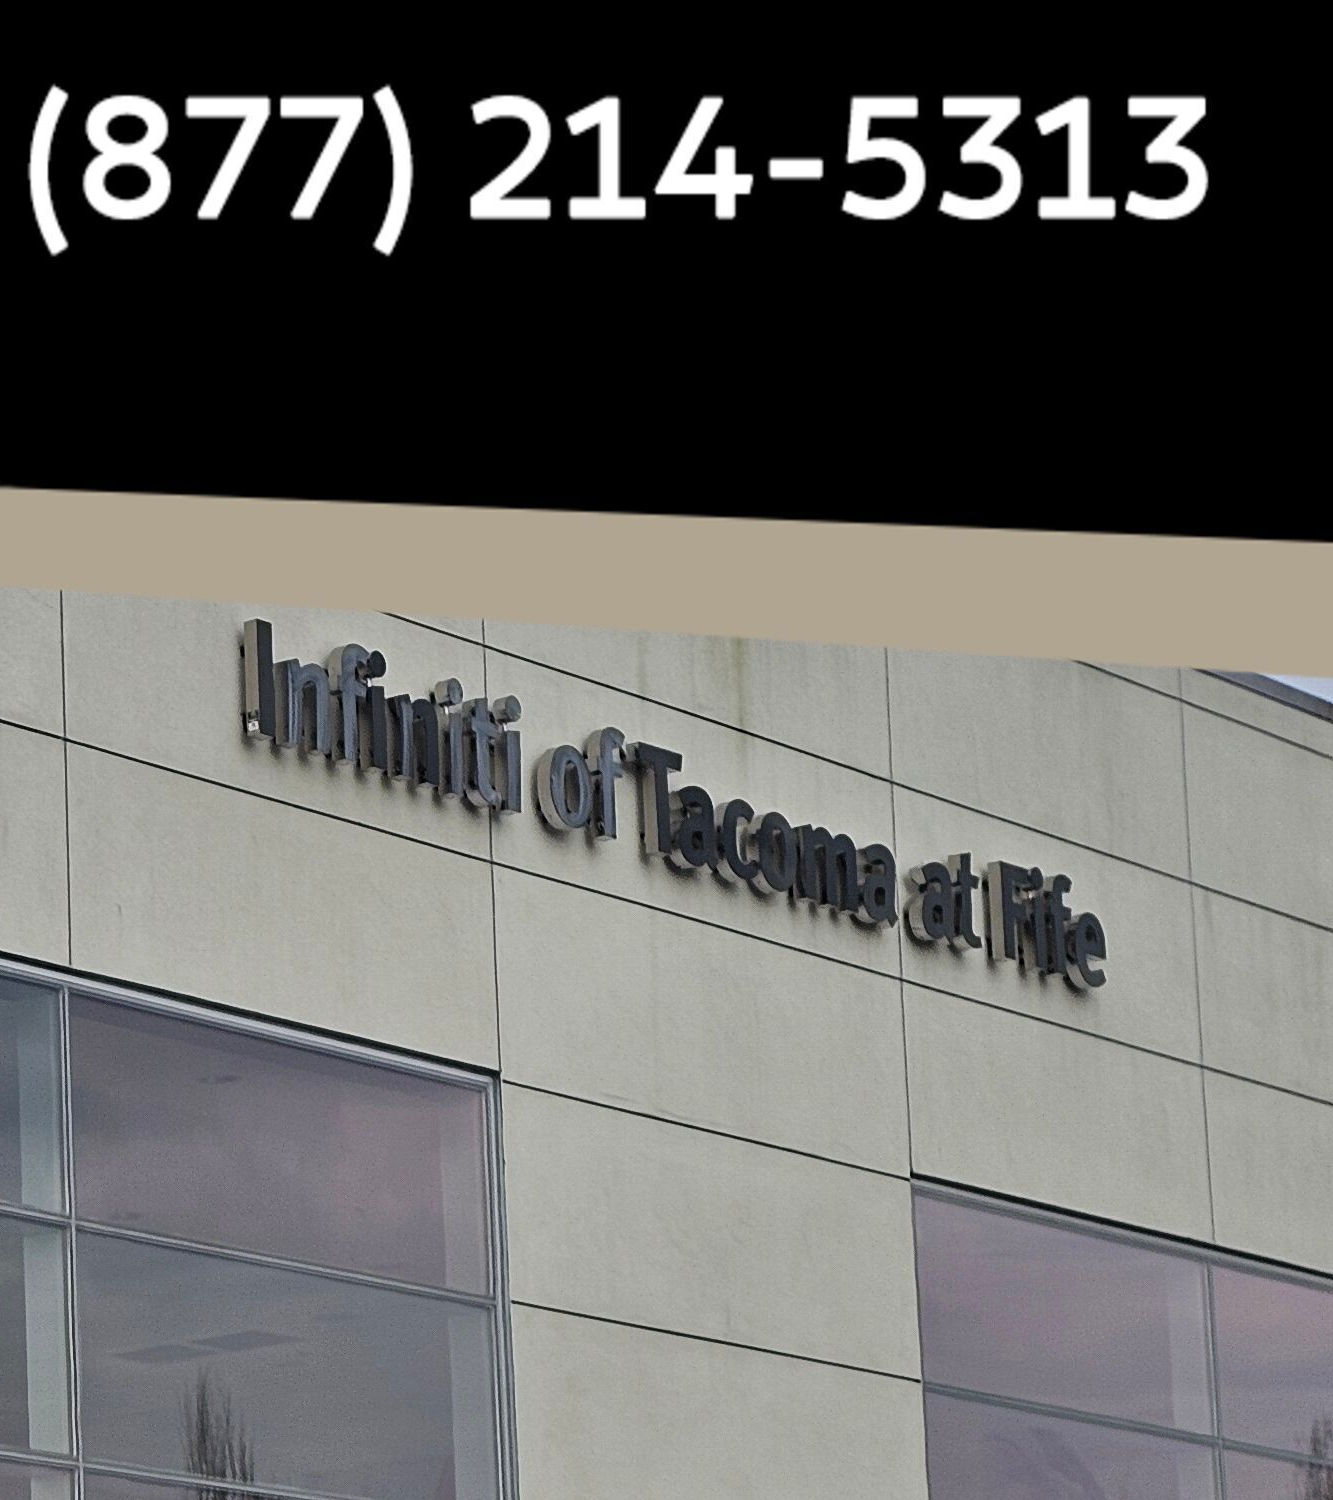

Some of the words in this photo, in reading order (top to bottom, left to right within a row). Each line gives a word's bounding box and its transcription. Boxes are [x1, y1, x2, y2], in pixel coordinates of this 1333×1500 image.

[240, 618, 523, 814] Infiniti
[535, 726, 627, 841] of
[626, 741, 897, 927] Tacoma
[905, 851, 981, 949] at
[986, 860, 1107, 988] Fife
